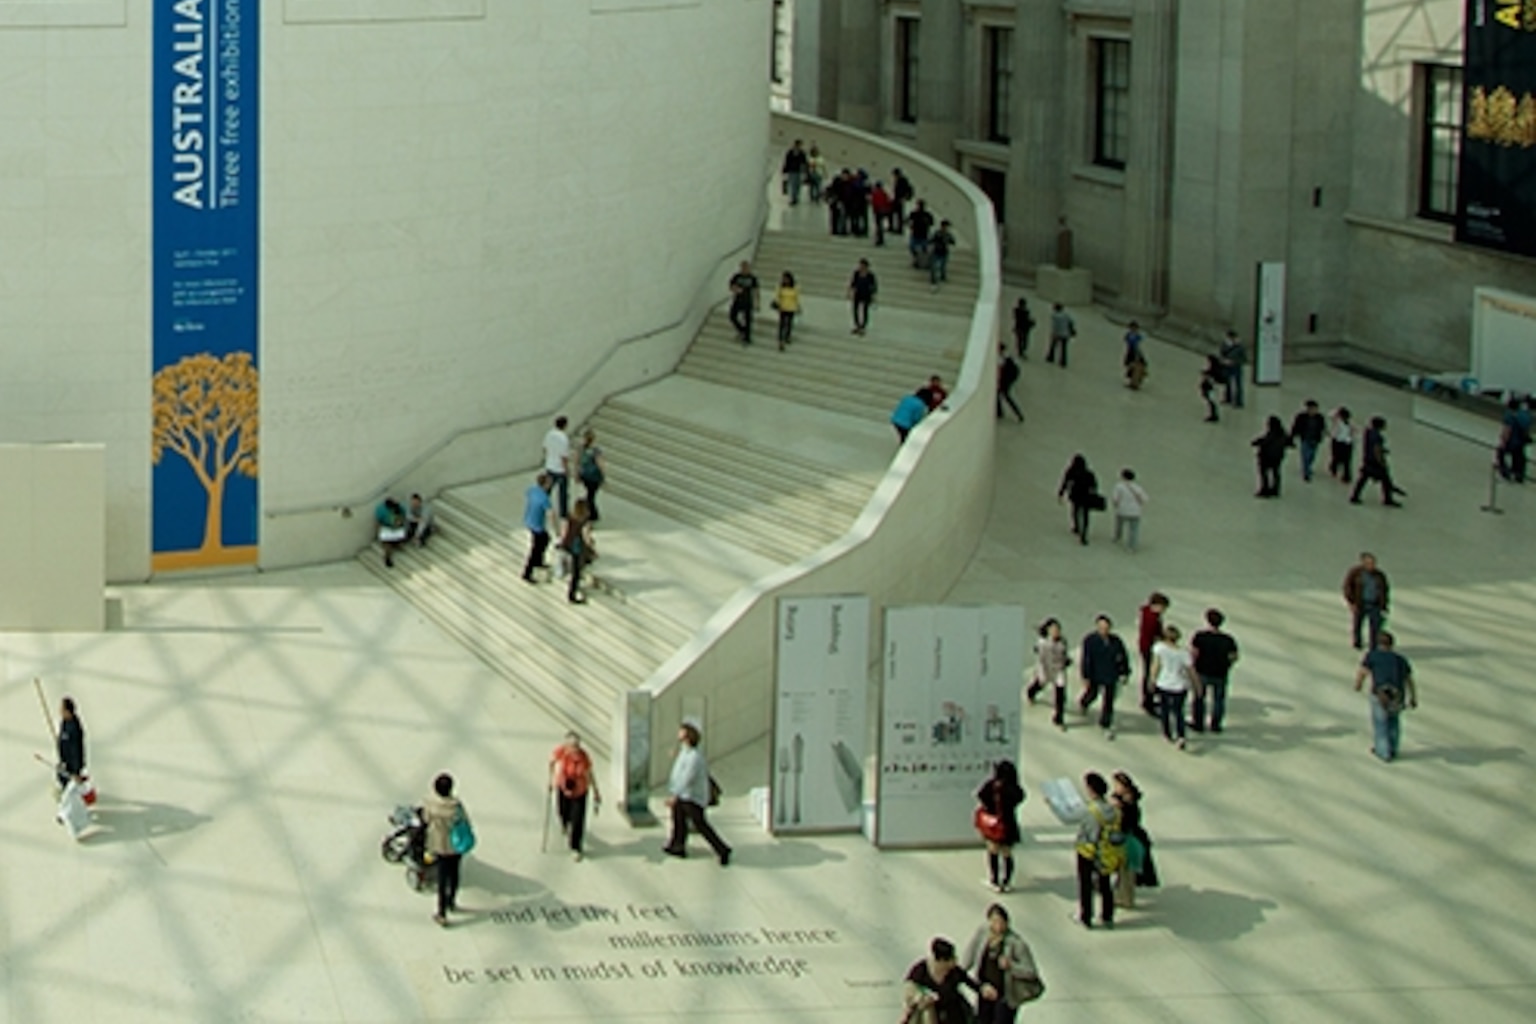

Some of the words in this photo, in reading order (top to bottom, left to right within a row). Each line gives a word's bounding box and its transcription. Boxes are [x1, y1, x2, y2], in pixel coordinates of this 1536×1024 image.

[220, 104, 240, 145] free
[220, 151, 241, 207] Three
[489, 906, 537, 924] and
[538, 905, 575, 923] let
[579, 903, 619, 925] thy
[626, 903, 679, 920] feet
[607, 929, 760, 950] millenniums
[761, 926, 841, 945] hence
[443, 964, 475, 985] be
[484, 964, 525, 984] set
[531, 966, 557, 982] in
[561, 960, 633, 982] midst
[641, 958, 667, 979] of
[673, 954, 813, 979] knowledge
